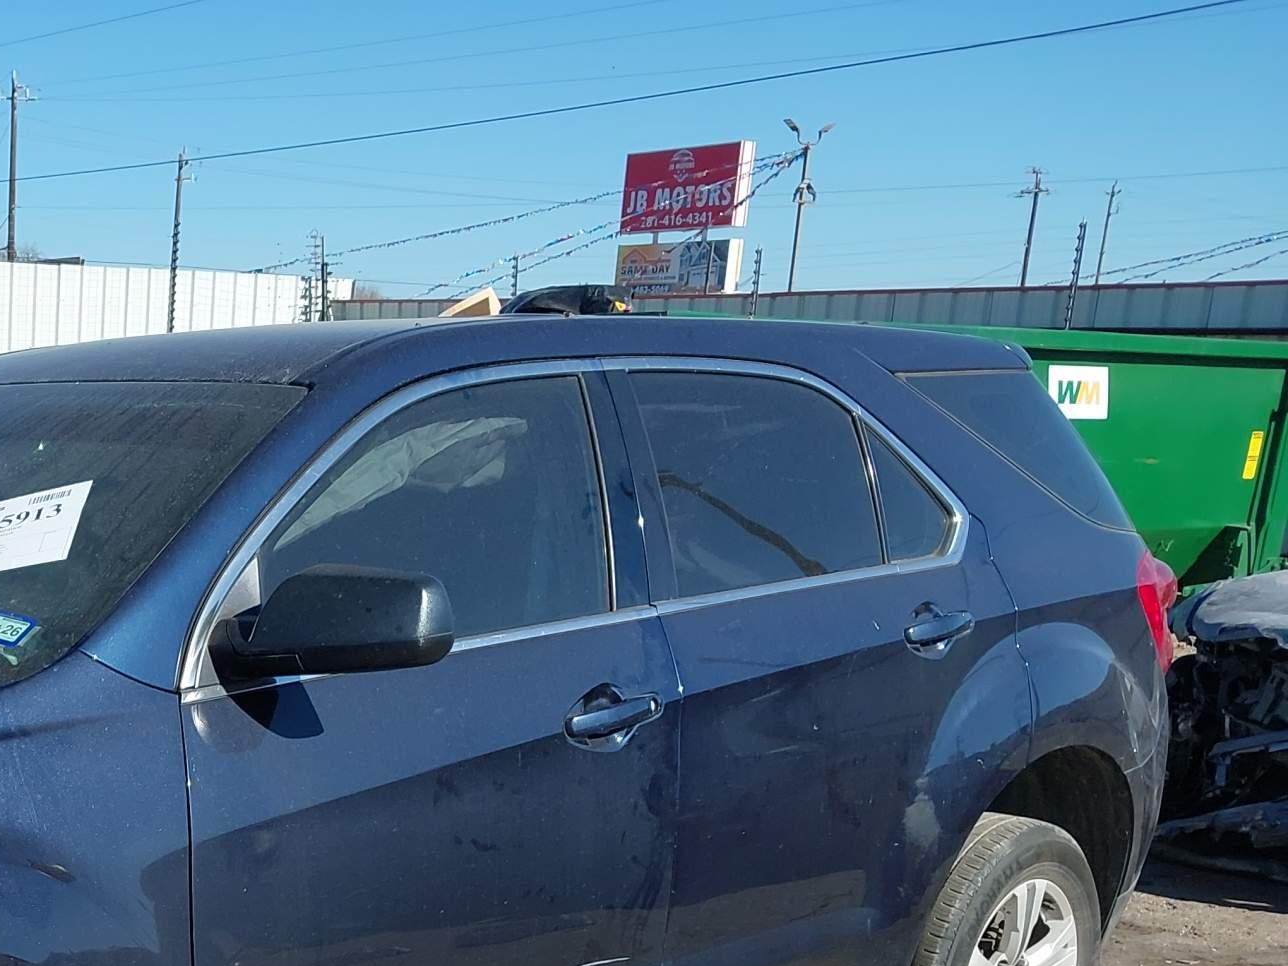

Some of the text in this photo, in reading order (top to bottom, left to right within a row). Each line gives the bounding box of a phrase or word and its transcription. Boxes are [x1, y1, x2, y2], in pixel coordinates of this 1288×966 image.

[626, 183, 732, 214] JB MOTORS
[652, 263, 671, 274] DAY
[1057, 379, 1100, 405] WM
[1, 623, 21, 637] 26
